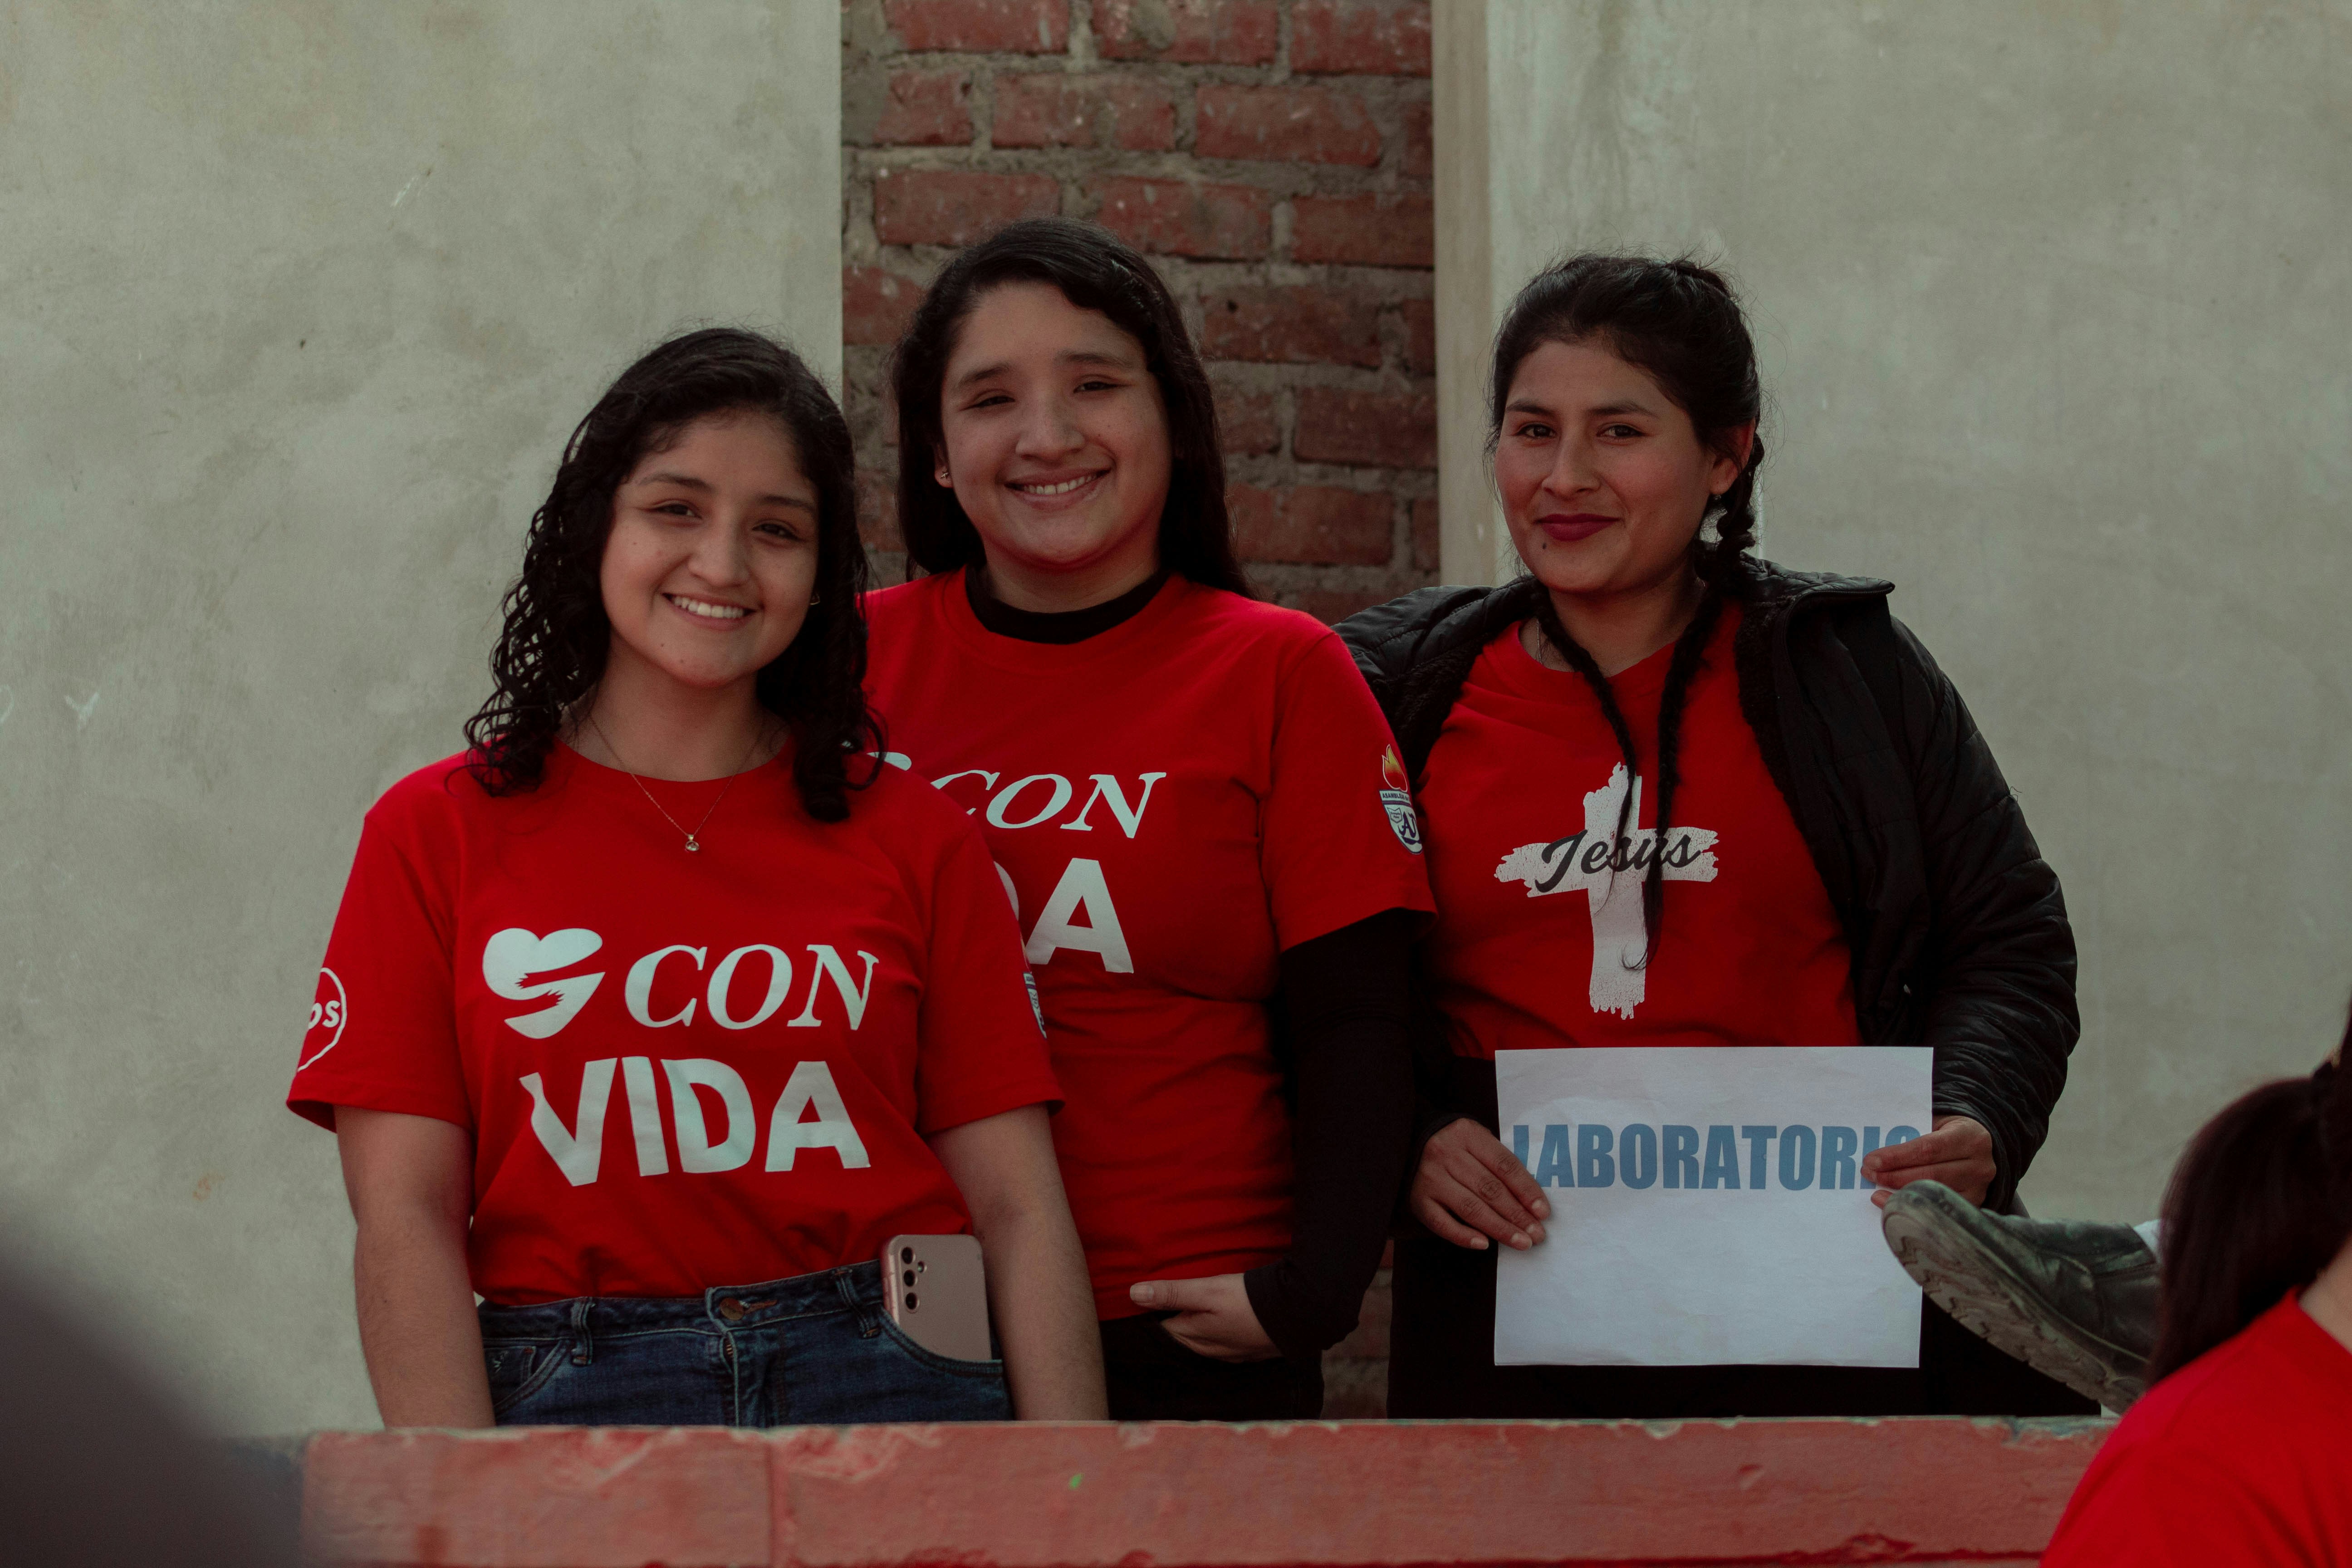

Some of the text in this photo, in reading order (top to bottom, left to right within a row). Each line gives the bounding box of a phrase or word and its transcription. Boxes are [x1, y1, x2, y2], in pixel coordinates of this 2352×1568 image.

[625, 944, 879, 1030] CON
[519, 1056, 871, 1187] VIDA
[1513, 1123, 1921, 1191] LABORATORI
